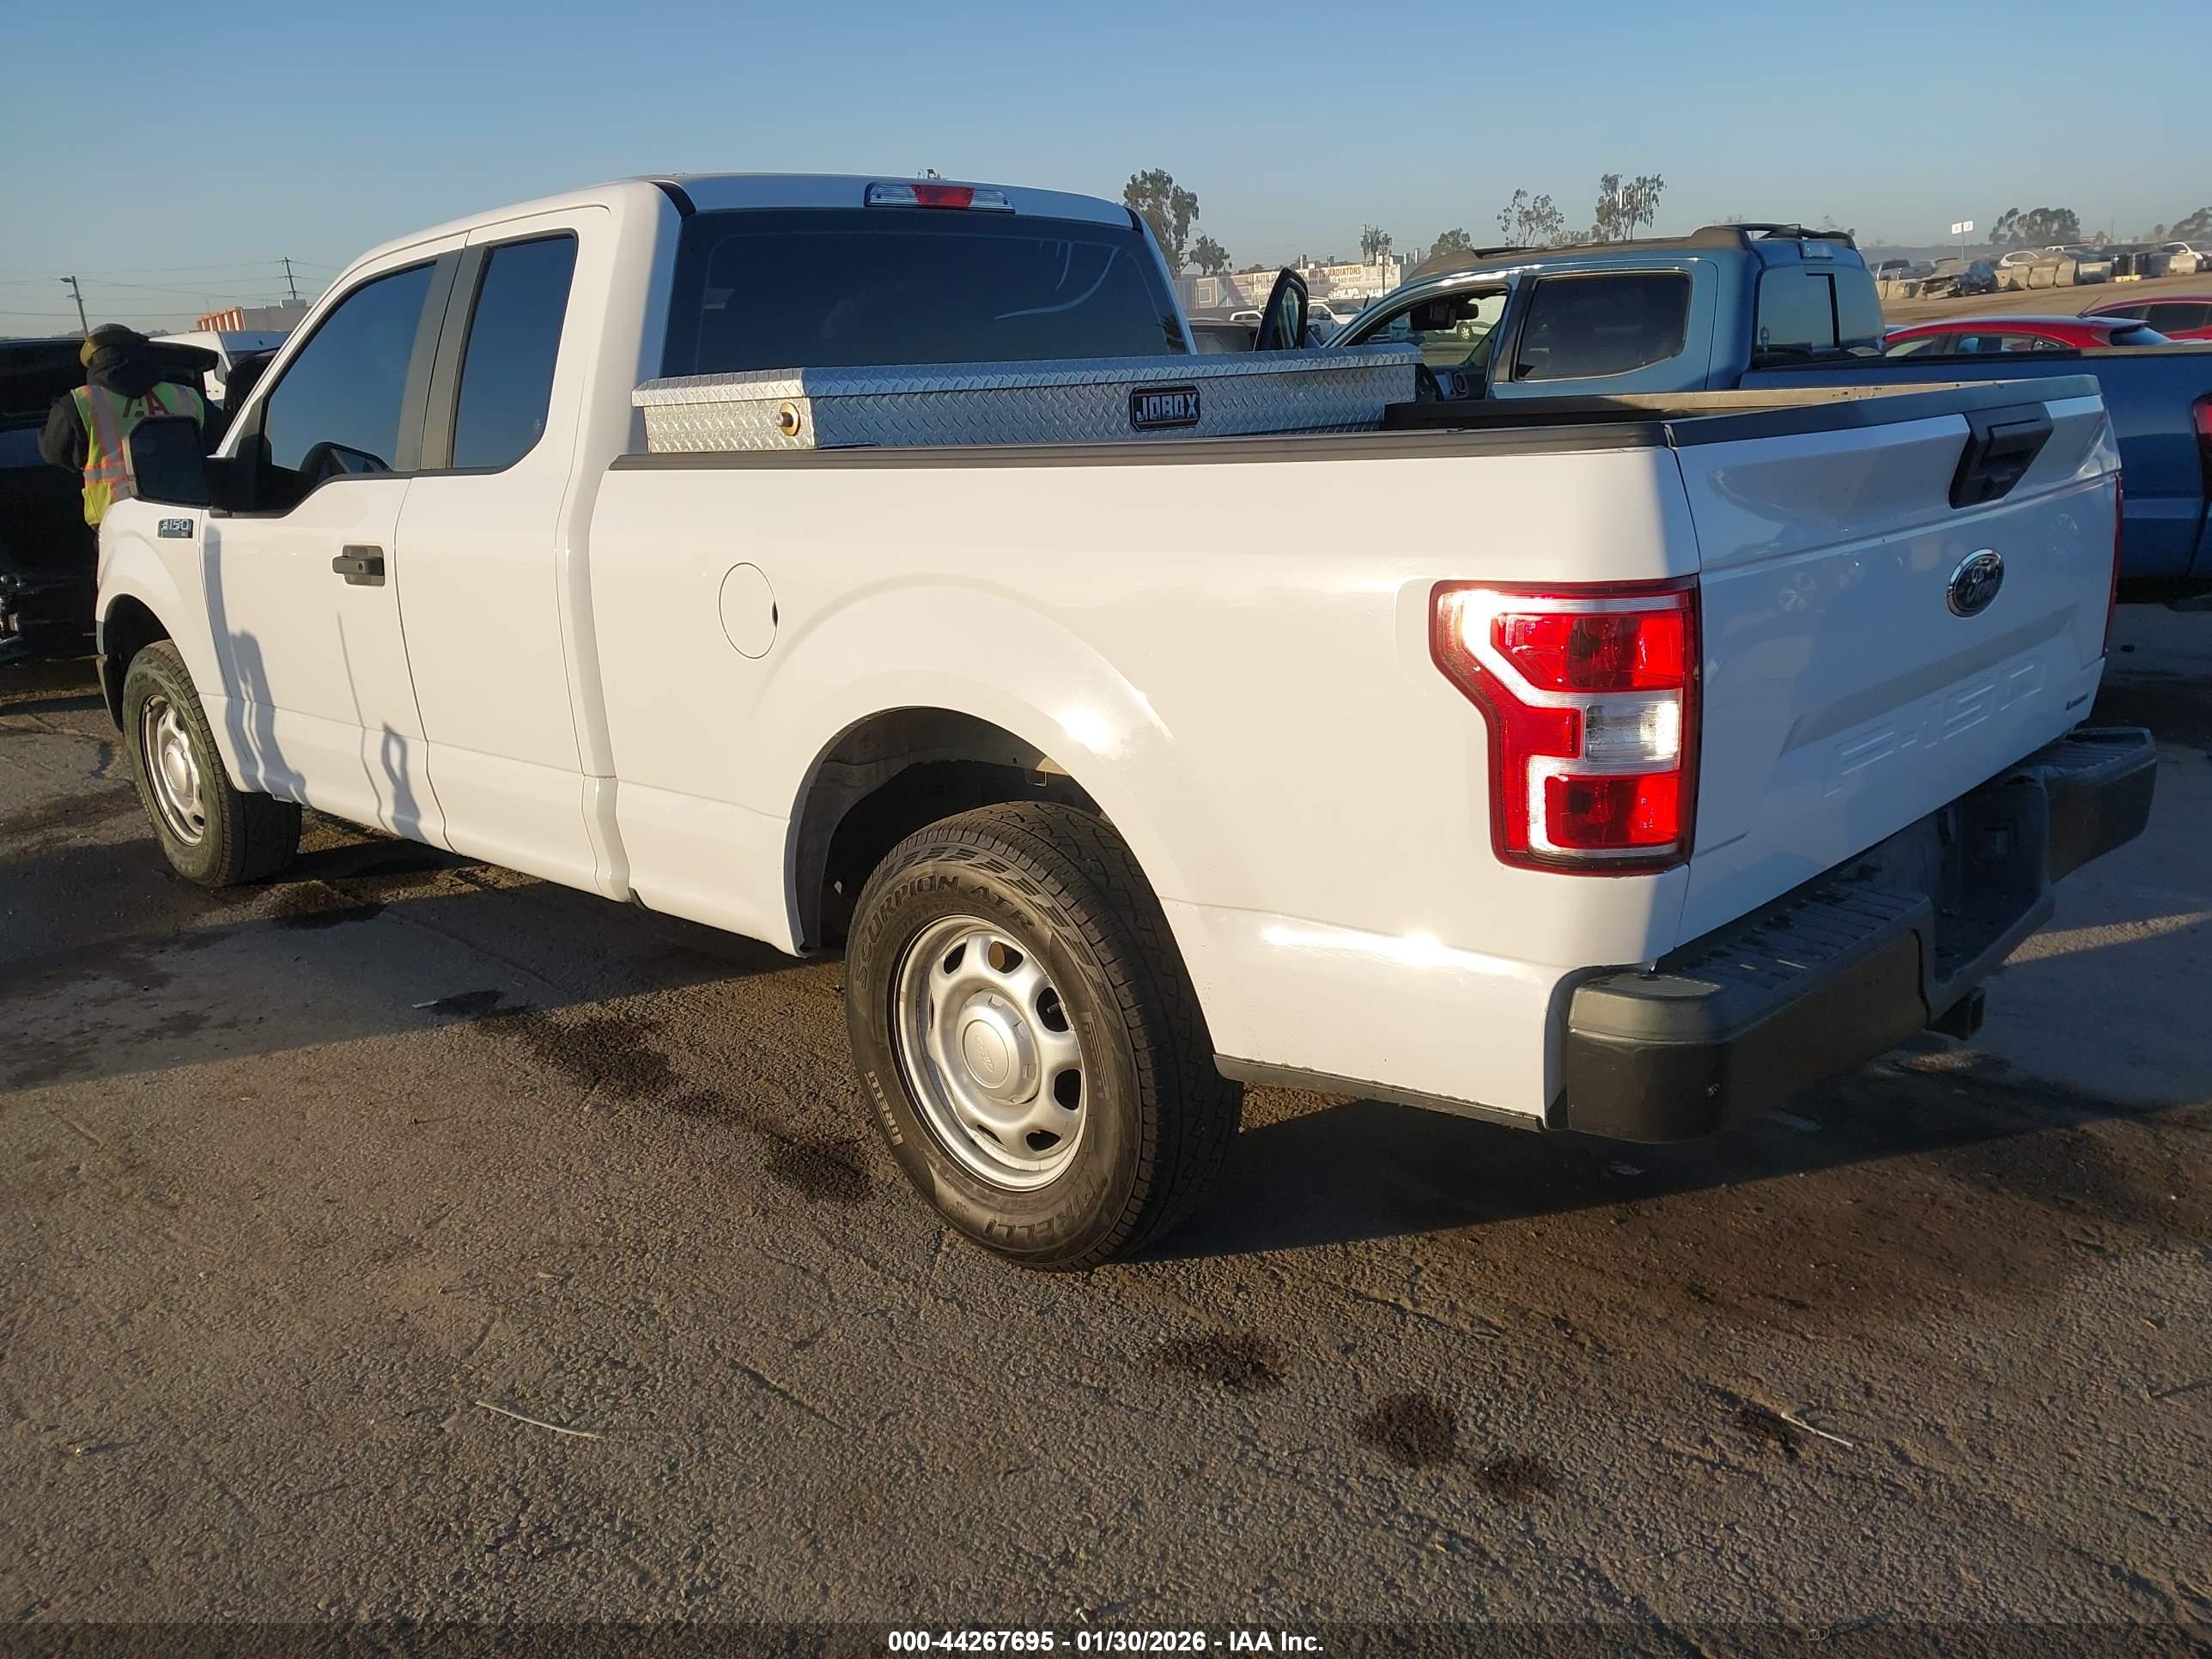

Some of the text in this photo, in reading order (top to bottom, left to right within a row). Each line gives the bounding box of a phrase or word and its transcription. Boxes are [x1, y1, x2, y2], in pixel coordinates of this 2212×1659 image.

[1255, 274, 1270, 284] AUTO
[1136, 393, 1198, 422] JOBOX
[855, 872, 959, 989] SCORPION
[866, 1071, 904, 1146] PIRELLI
[983, 1175, 1097, 1244] PIRELLI
